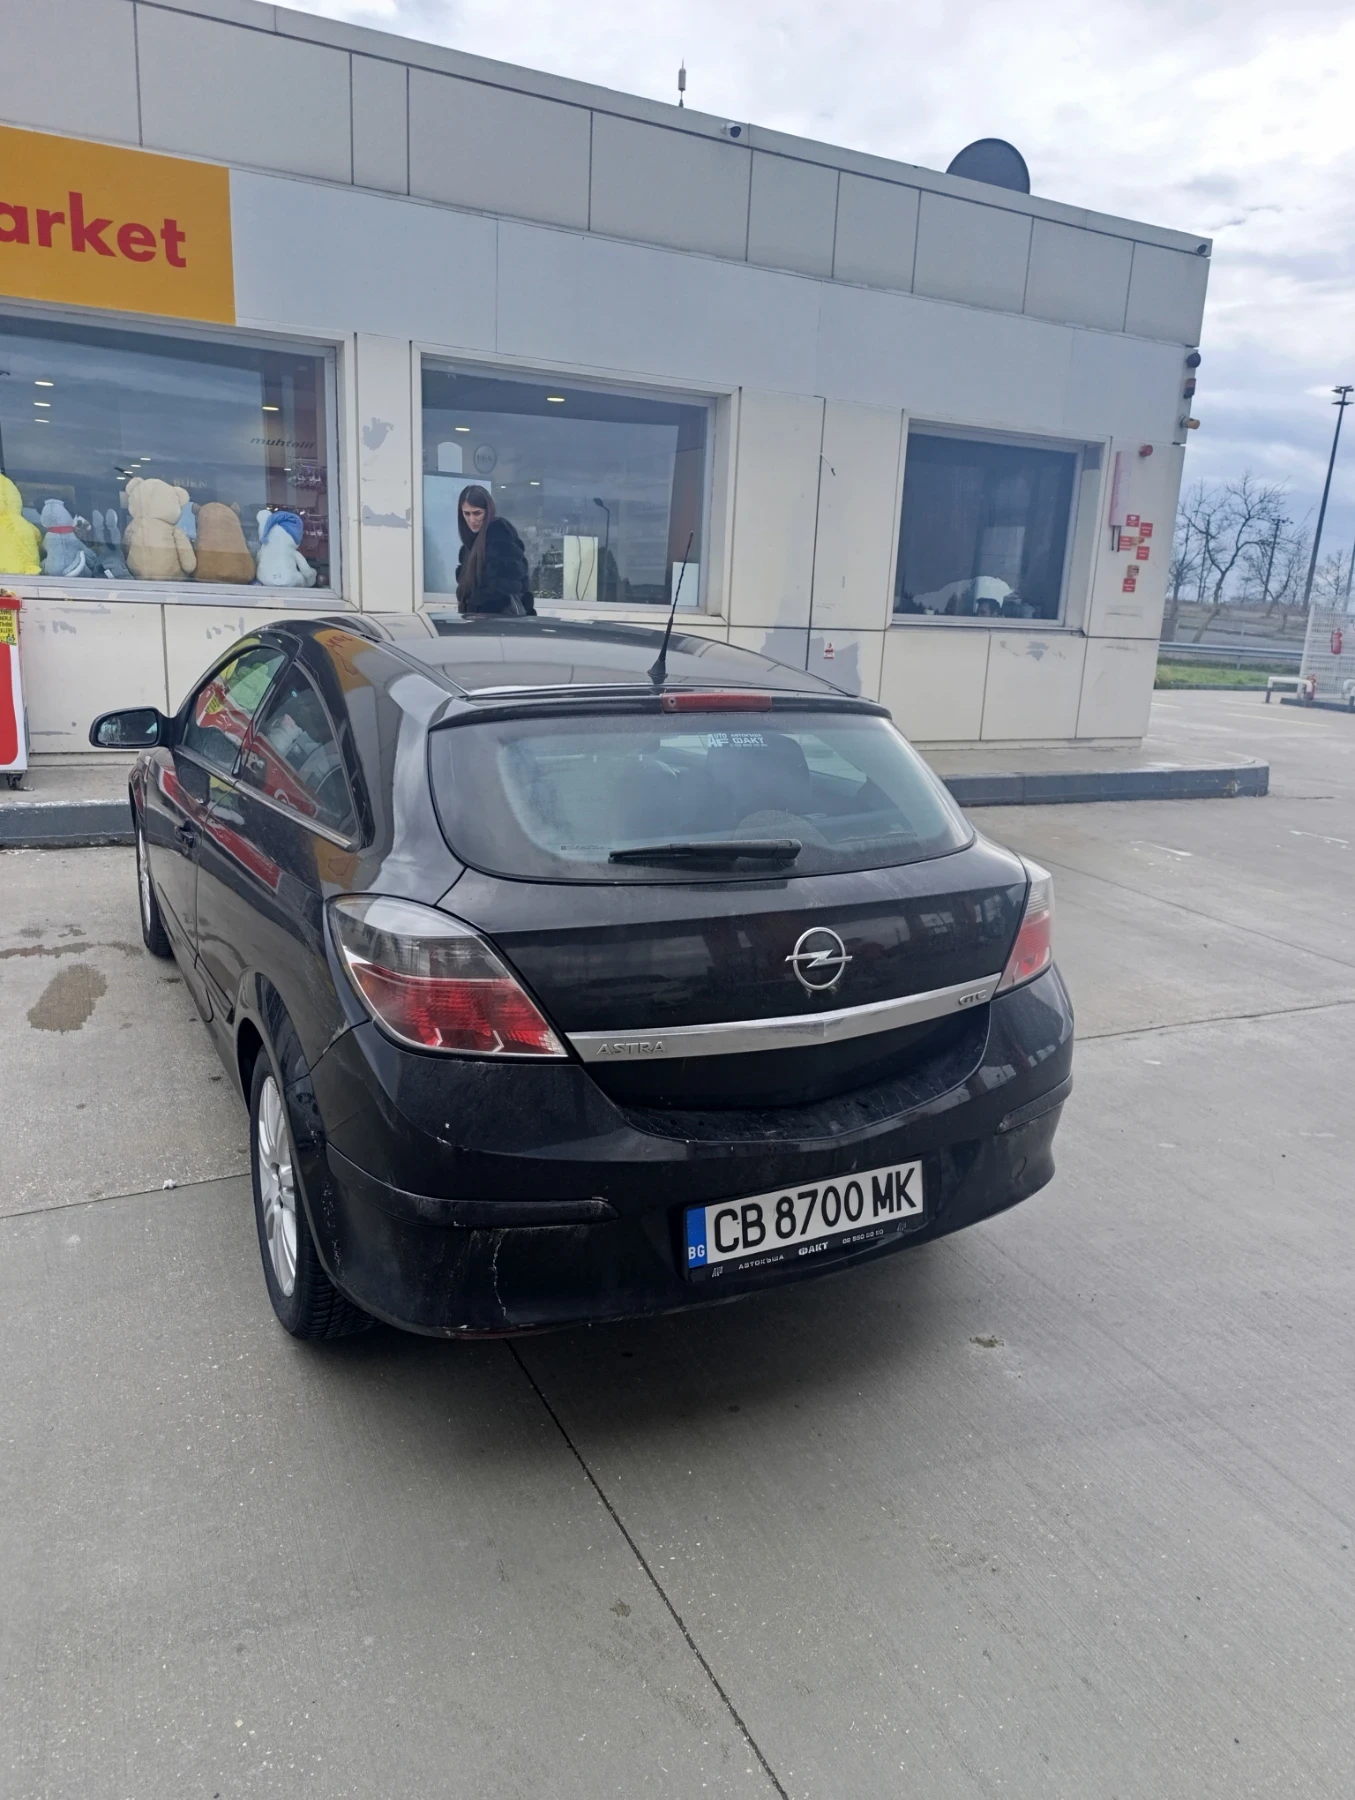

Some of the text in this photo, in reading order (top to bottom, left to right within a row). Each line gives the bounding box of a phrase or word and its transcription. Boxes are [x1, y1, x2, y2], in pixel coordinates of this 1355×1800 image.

[958, 989, 987, 1005] GTC
[596, 1041, 665, 1055] ASTRA
[713, 1168, 917, 1254] CB 8700 MK
[688, 1244, 705, 1260] BG
[798, 1241, 829, 1256] ФАКТ
